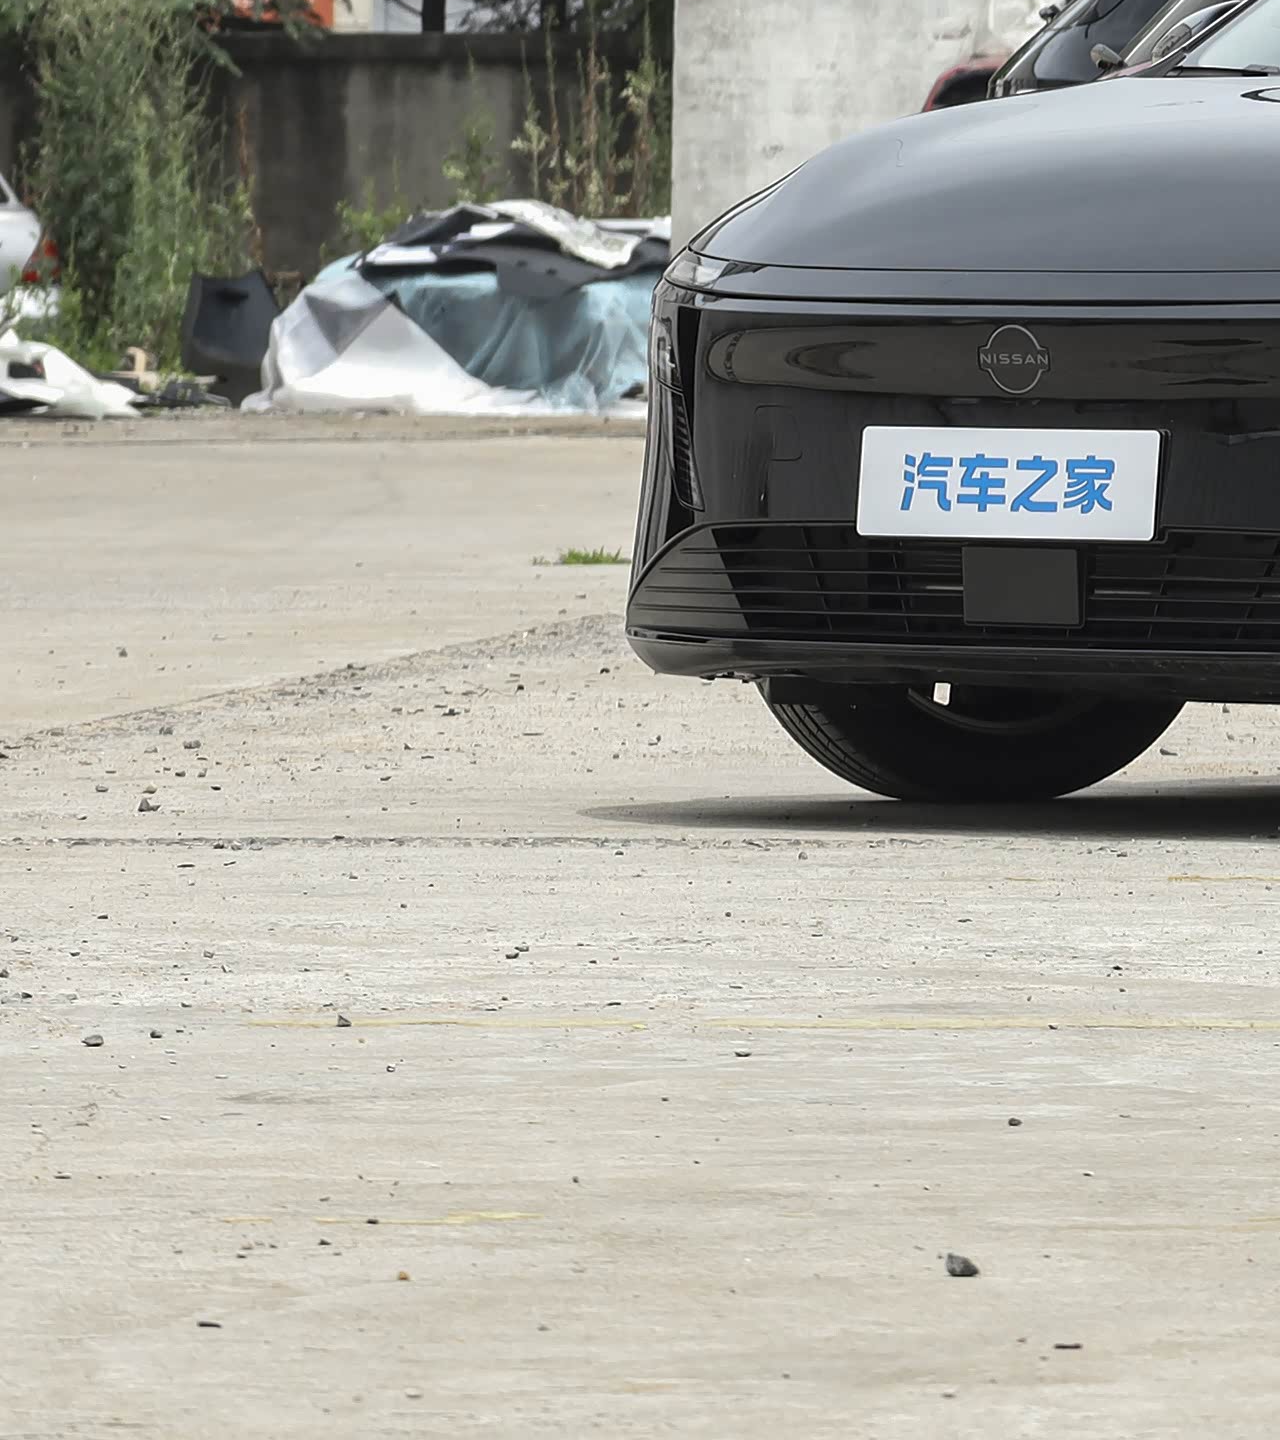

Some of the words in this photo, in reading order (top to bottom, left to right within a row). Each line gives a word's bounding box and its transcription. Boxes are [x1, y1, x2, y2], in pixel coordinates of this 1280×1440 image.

[979, 352, 1049, 366] NISSAN
[900, 452, 1116, 514] 汽车之家
